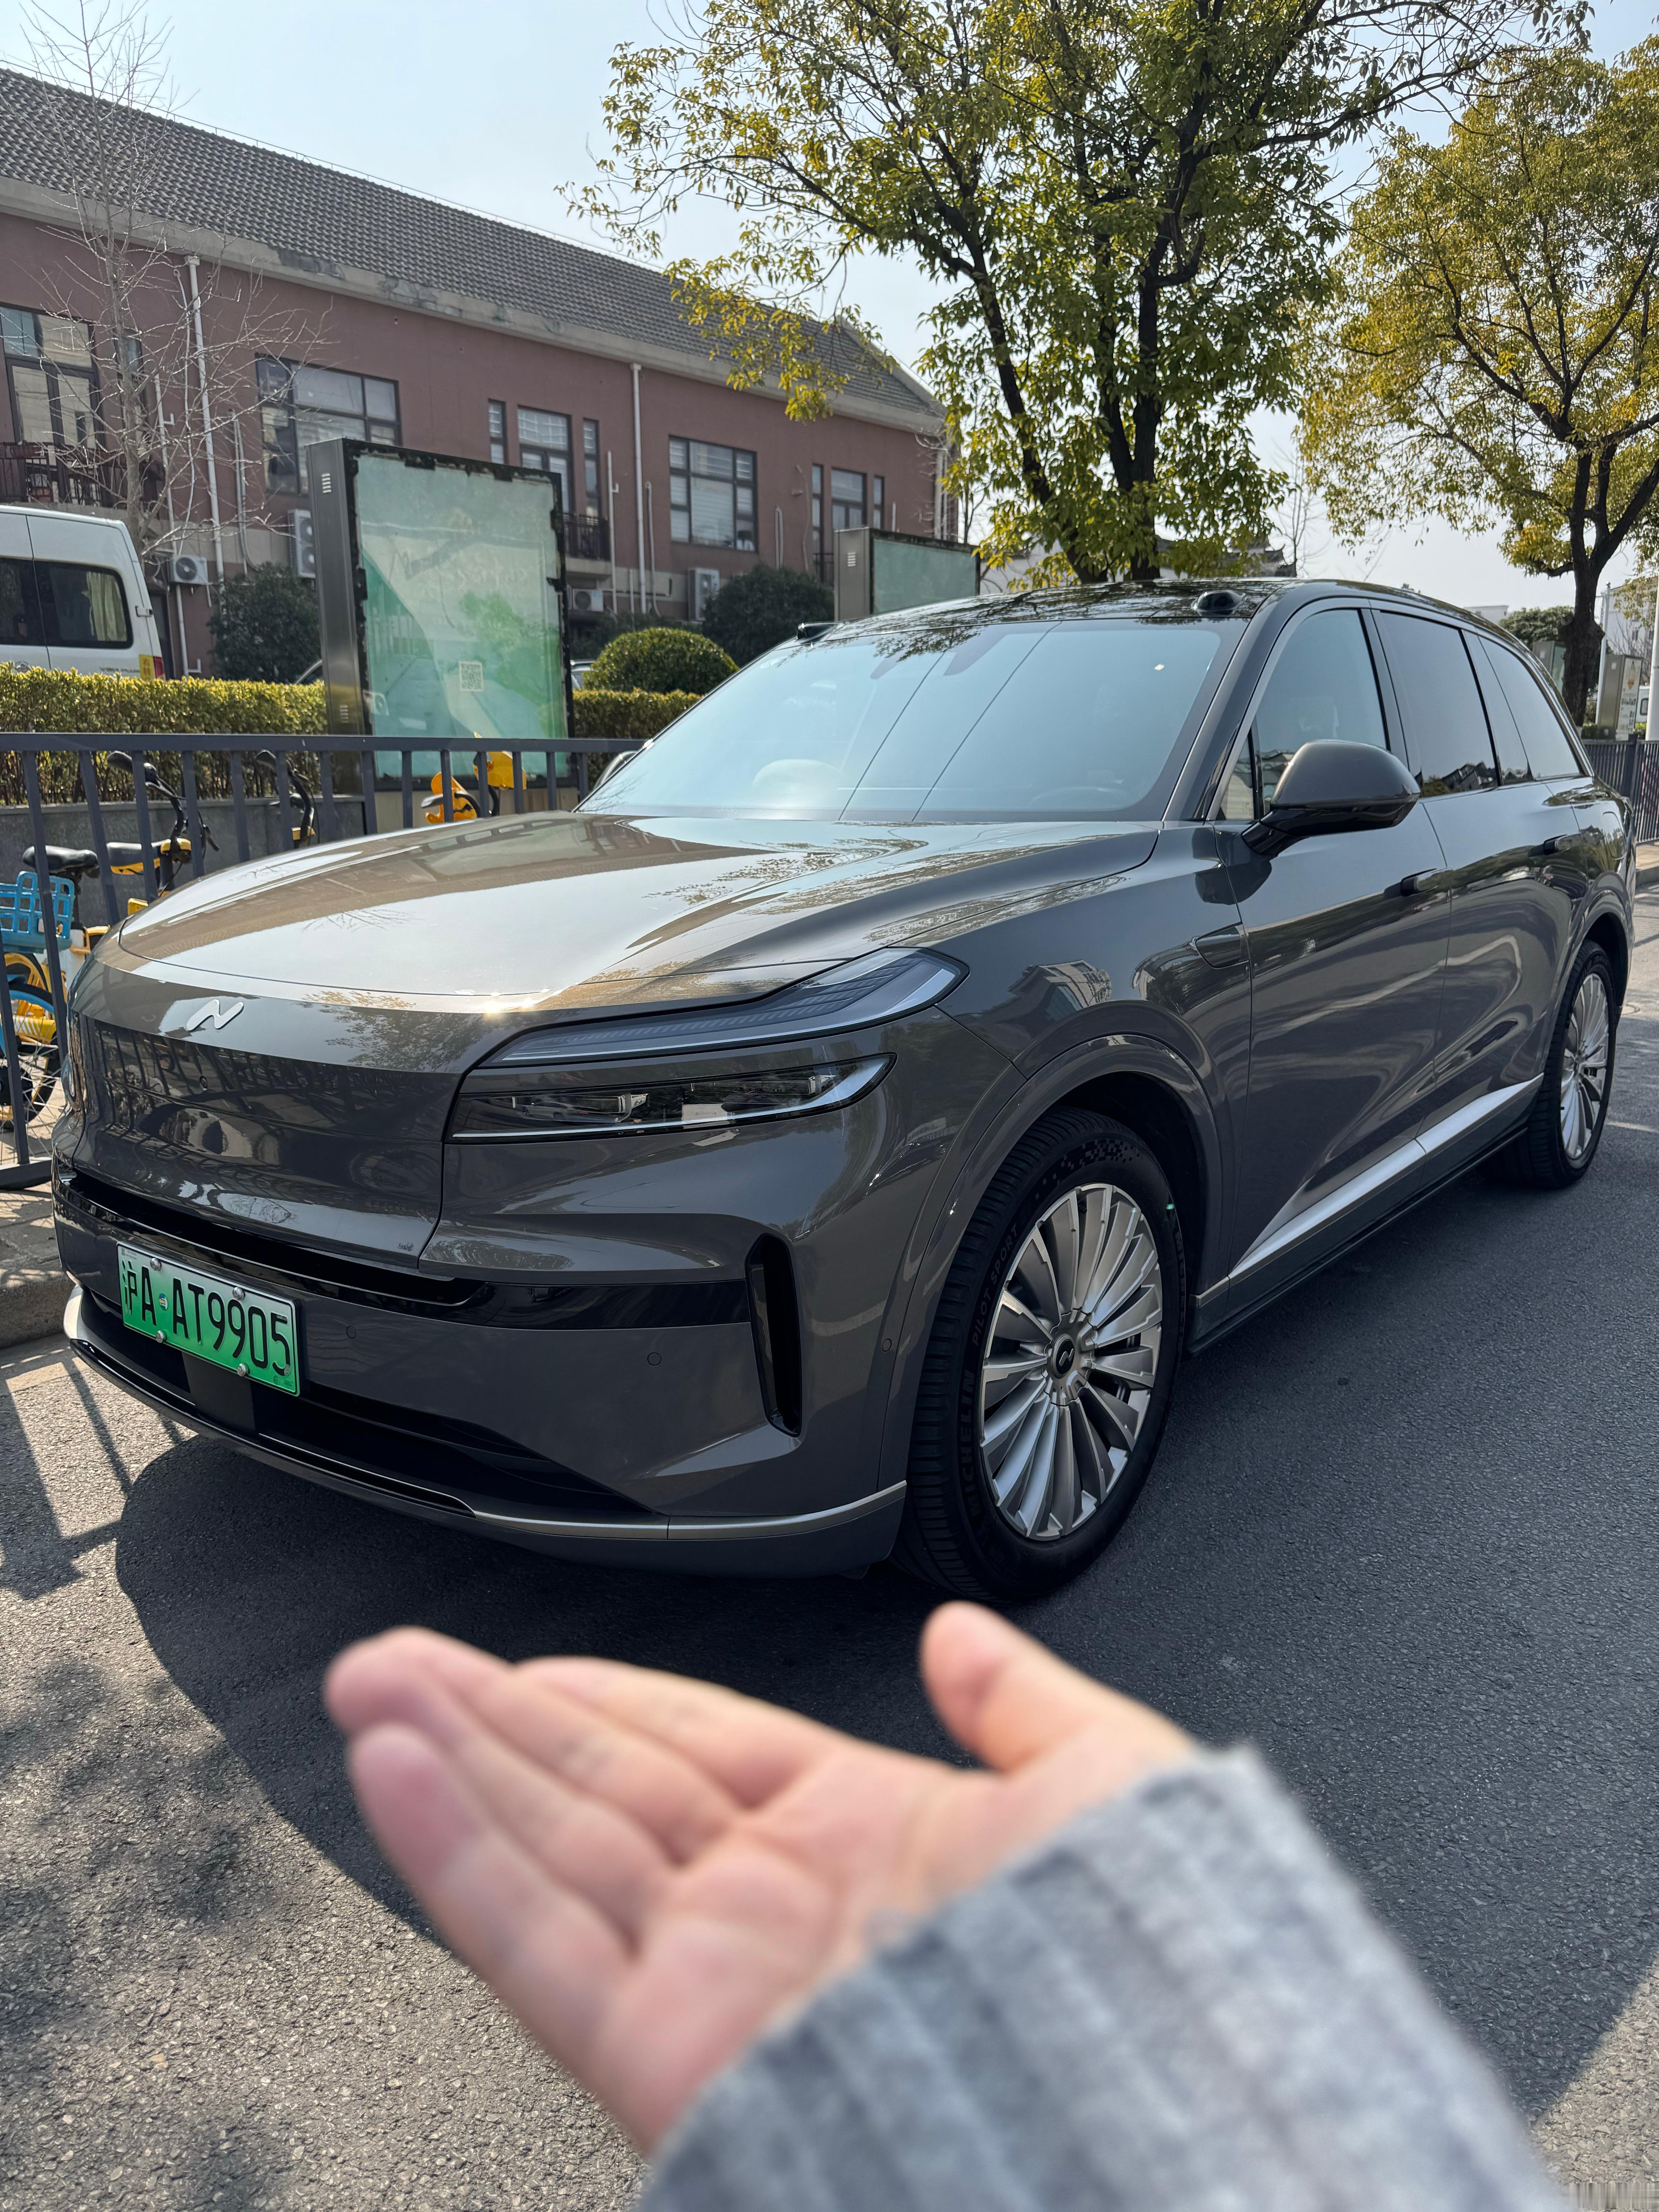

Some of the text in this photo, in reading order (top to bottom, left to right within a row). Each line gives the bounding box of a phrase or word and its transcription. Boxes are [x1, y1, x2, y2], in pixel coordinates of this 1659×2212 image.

[173, 1278, 290, 1376] AT9905
[972, 1286, 991, 1346] PILOT
[991, 1223, 1017, 1285] SPORT
[960, 1369, 982, 1518] MICHELIN
